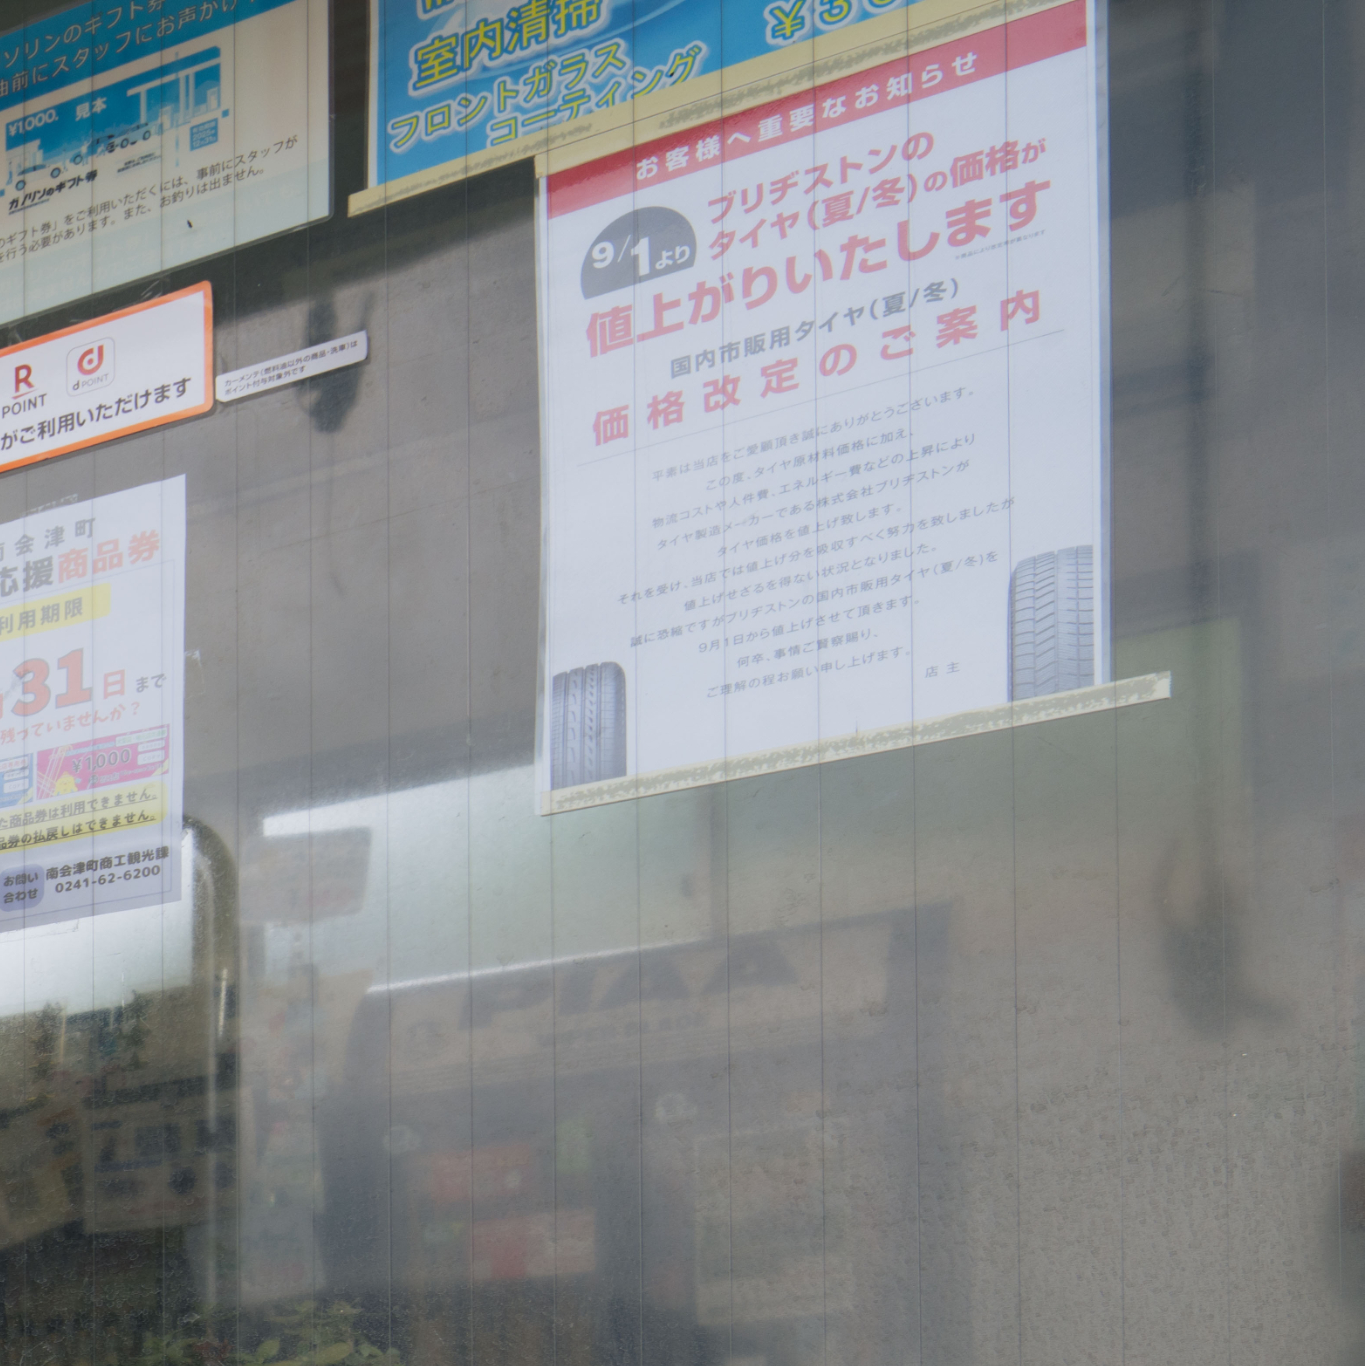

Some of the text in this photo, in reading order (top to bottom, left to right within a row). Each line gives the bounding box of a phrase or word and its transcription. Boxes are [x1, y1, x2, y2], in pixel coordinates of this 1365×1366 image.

[415, 0, 599, 89] 室内清掃
[75, 96, 108, 121] 見本
[392, 43, 627, 150] フロントガラス
[490, 44, 700, 147] コーティング
[635, 52, 980, 181] お客様へ重要なお知らせ
[708, 130, 935, 225] ブリヂストンの
[586, 180, 1052, 358] 値上がりいたします
[669, 276, 960, 380] 国内市販用タイヤ(夏/冬)
[14, 363, 32, 394] R
[224, 365, 306, 396] ポイント付与対象外です
[592, 287, 1044, 448] 価格改定のご案内
[0, 392, 47, 419] POINT
[3, 871, 39, 887] お問い
[45, 846, 170, 881] 南会津町商工観光課
[55, 864, 161, 894] 0241-62-6200
[3, 888, 39, 904] 合わせ
